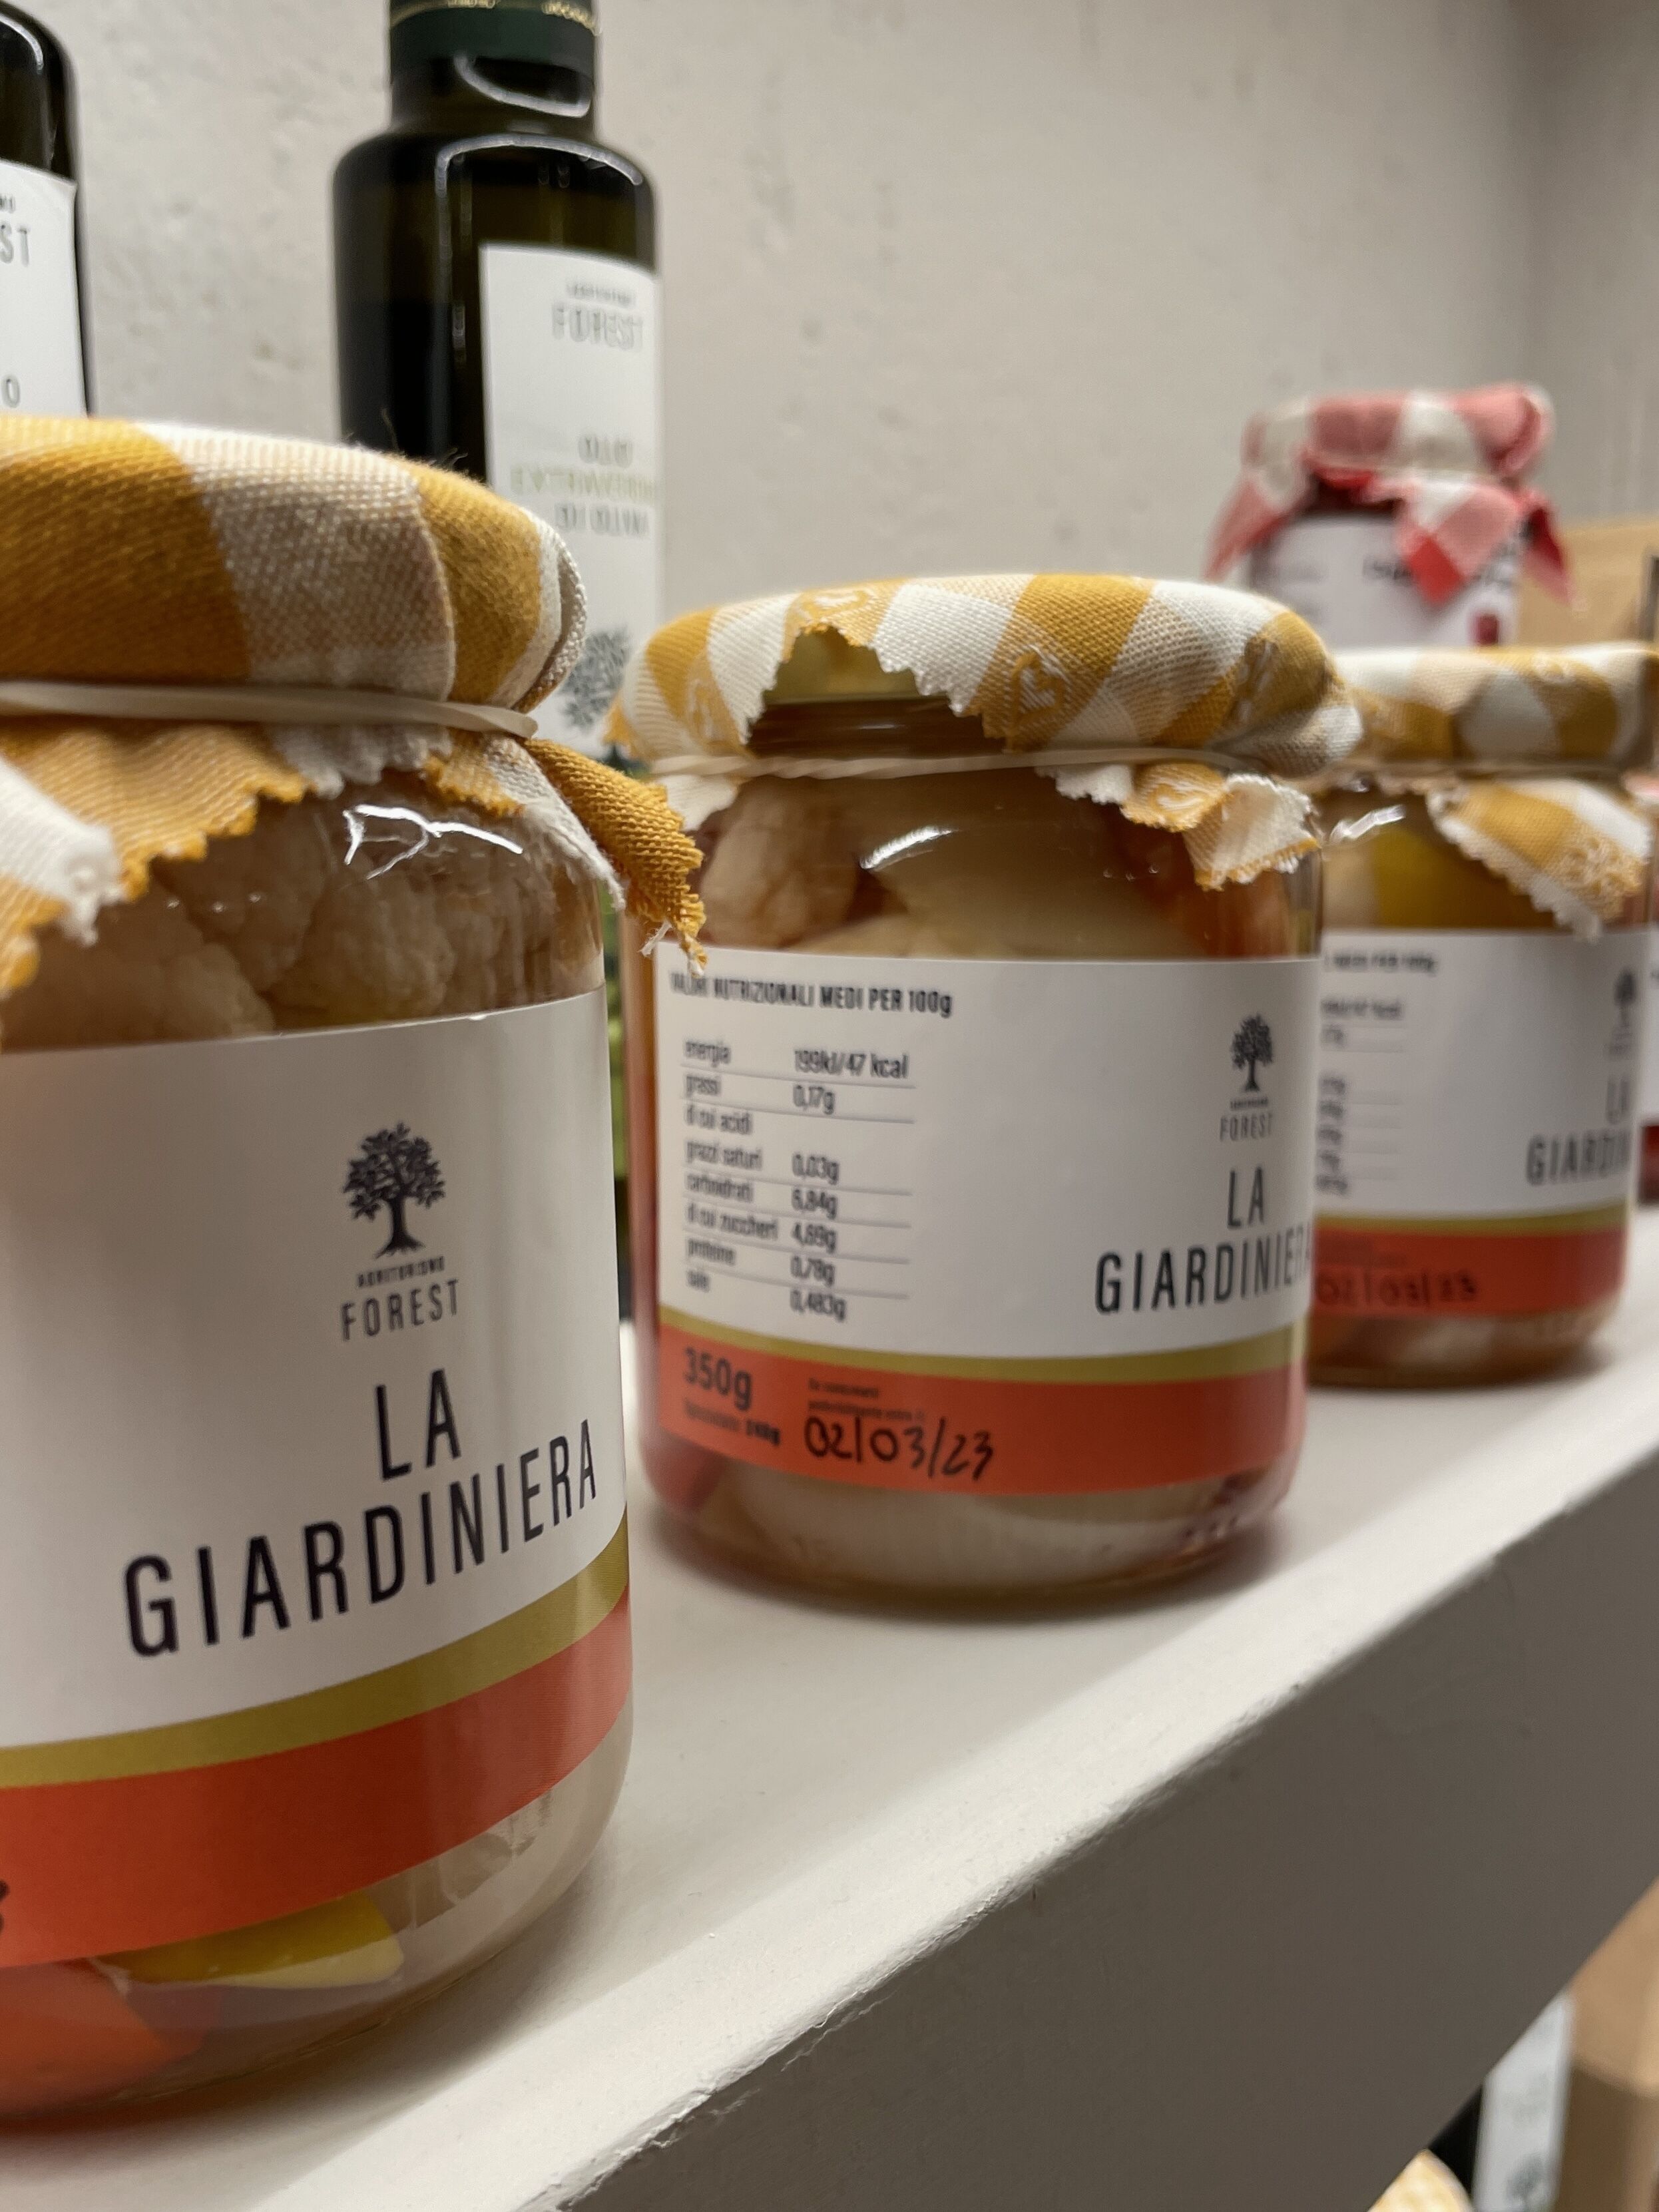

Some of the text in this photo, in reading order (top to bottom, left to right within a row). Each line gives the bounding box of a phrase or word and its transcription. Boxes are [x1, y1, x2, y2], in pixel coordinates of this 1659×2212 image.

[820, 986, 863, 1010] MEDI
[868, 988, 903, 1012] PER
[908, 990, 953, 1018] 100g
[870, 1052, 910, 1079] kcal
[1227, 1165, 1265, 1229] LA
[342, 1278, 459, 1343] FOREST
[684, 1346, 753, 1412] 350g
[374, 1368, 462, 1481] LA
[122, 1418, 596, 1658] GIARDINIERA
